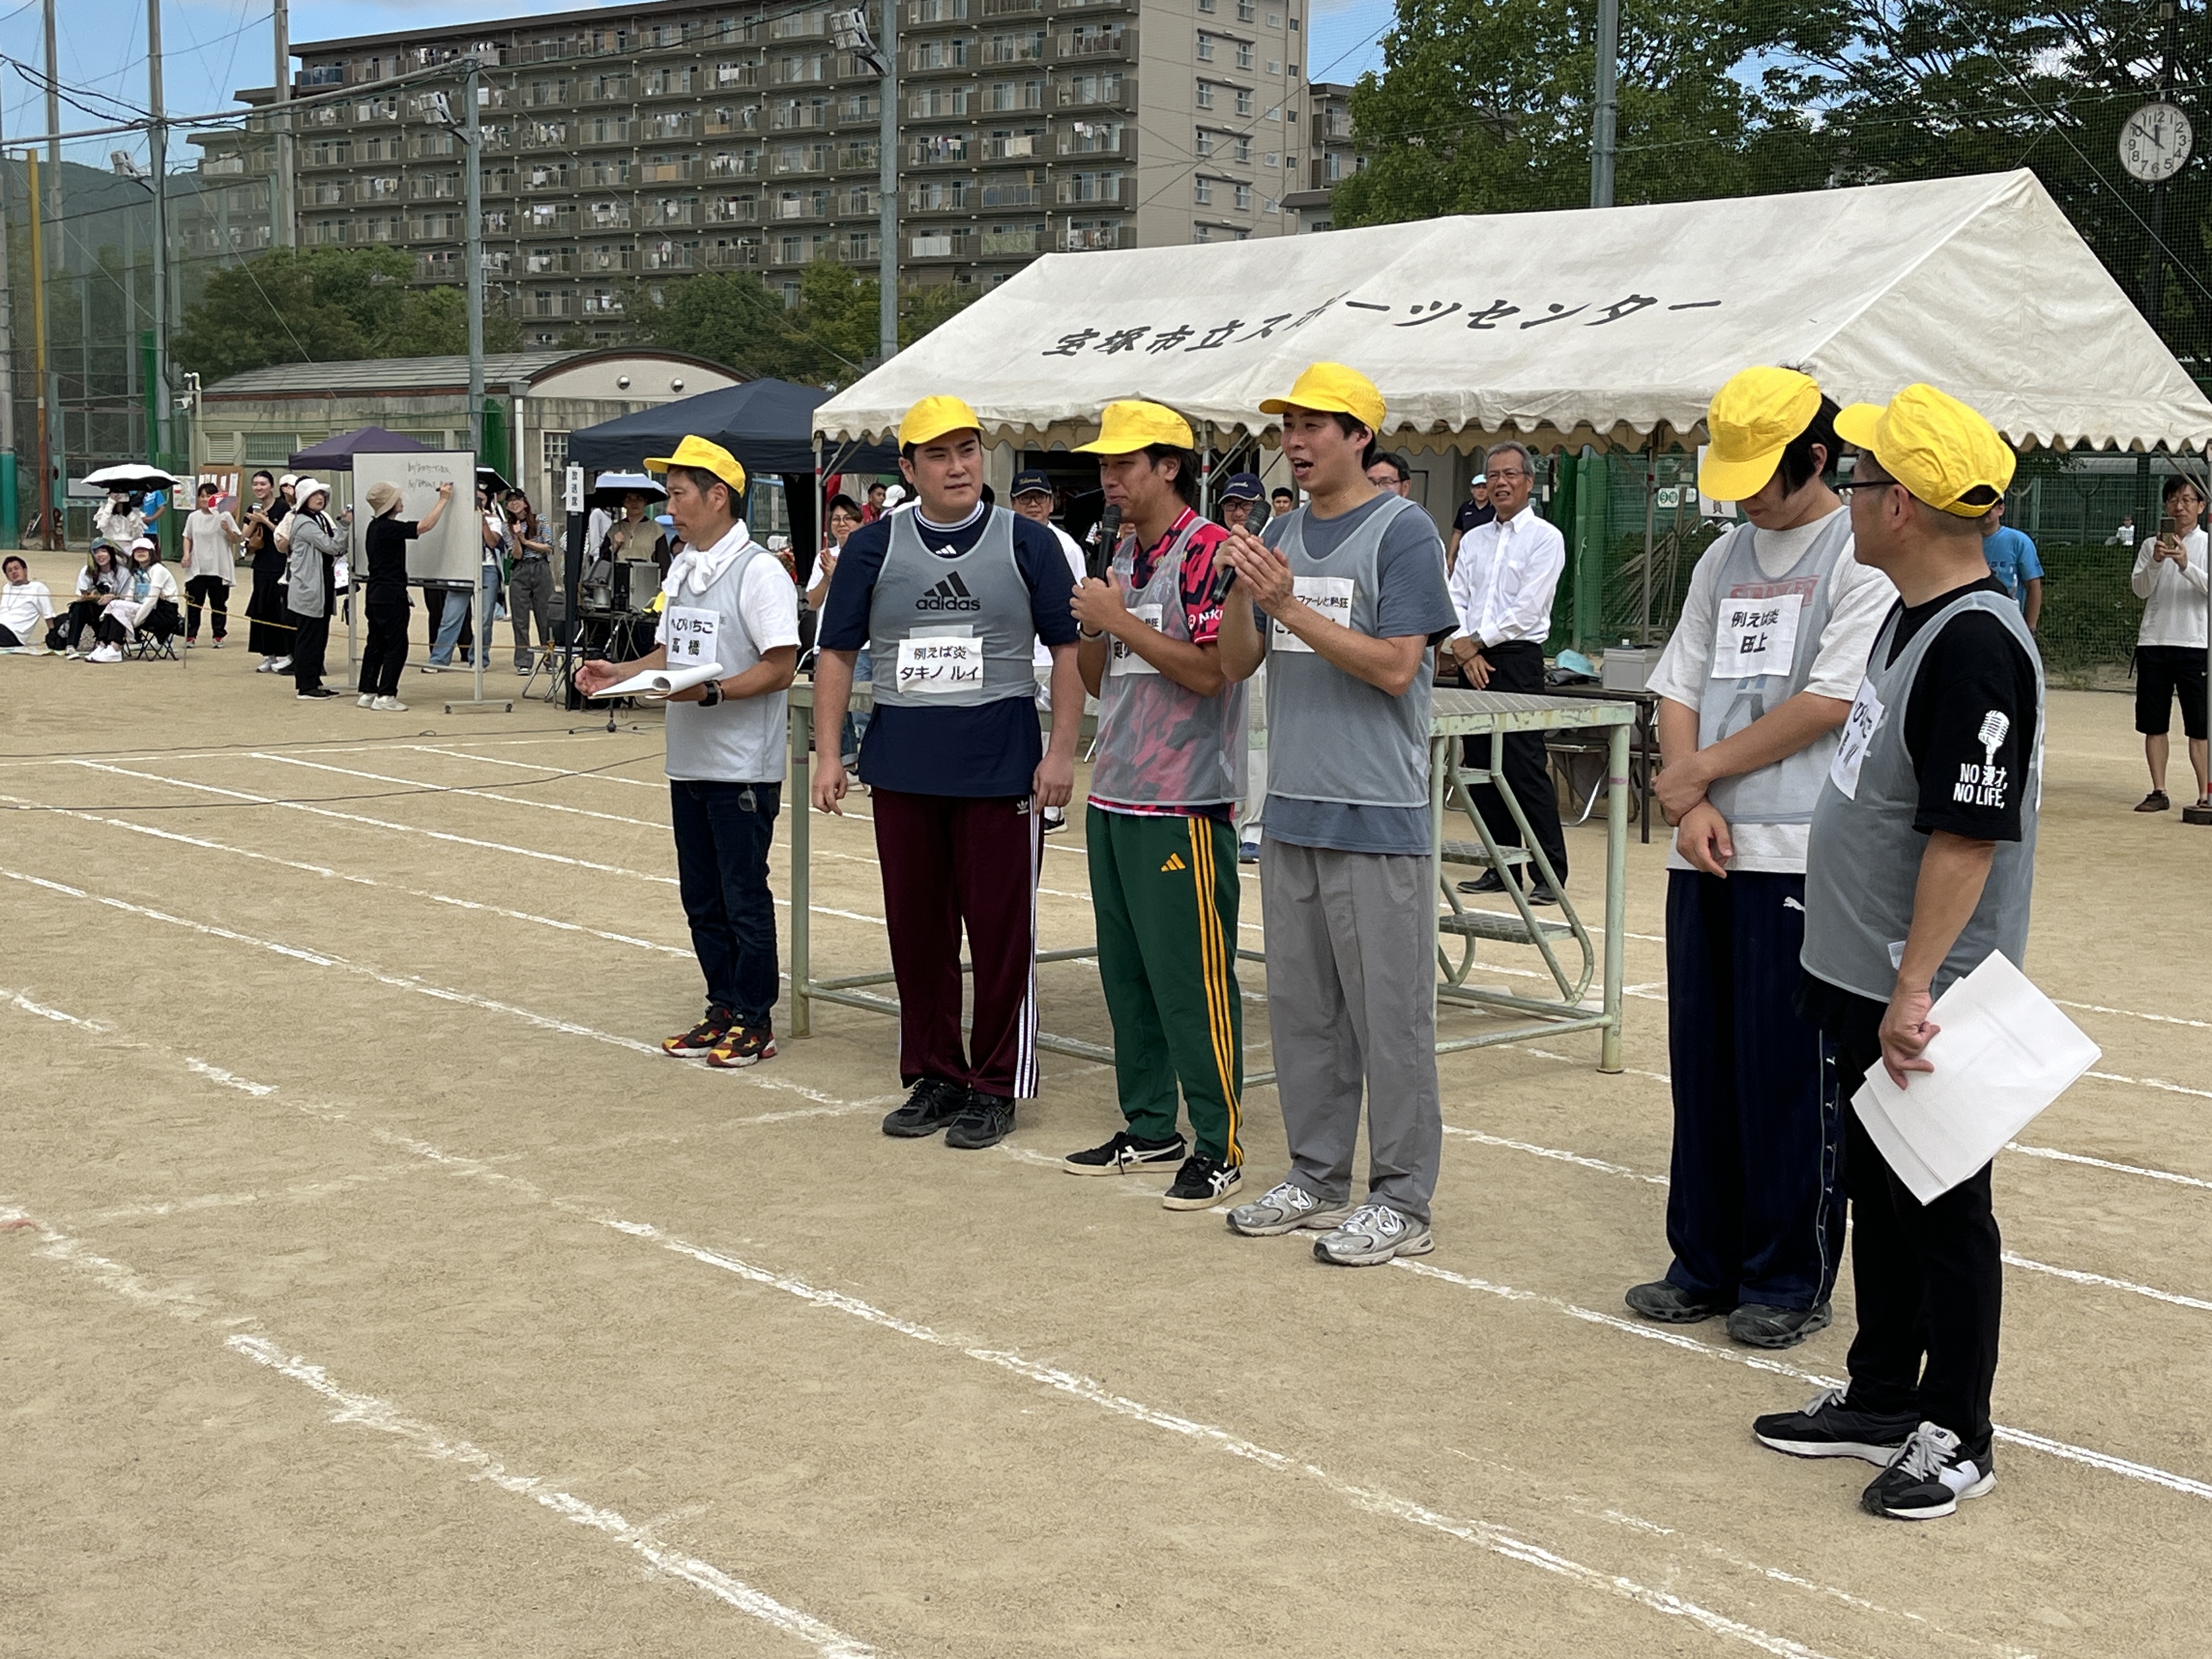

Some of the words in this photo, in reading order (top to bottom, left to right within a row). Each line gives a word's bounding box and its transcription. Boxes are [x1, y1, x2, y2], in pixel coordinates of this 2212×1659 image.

[2143, 115, 2152, 126] 11
[2154, 111, 2165, 123] 12
[2131, 126, 2143, 137] 10
[2176, 122, 2184, 133] 2
[2129, 139, 2136, 150] 9
[2179, 135, 2187, 146] 3
[2131, 151, 2140, 162] 8
[2174, 148, 2182, 158] 4
[2141, 160, 2148, 172] 7
[2152, 162, 2159, 174] 6
[2164, 159, 2172, 170] 5
[915, 596, 981, 611] adidas
[1731, 608, 1780, 628] 例えば炎
[1740, 632, 1768, 653] 田上
[914, 646, 966, 660] 例えば炎
[1960, 763, 1979, 783] NO
[1953, 782, 1974, 803] NO
